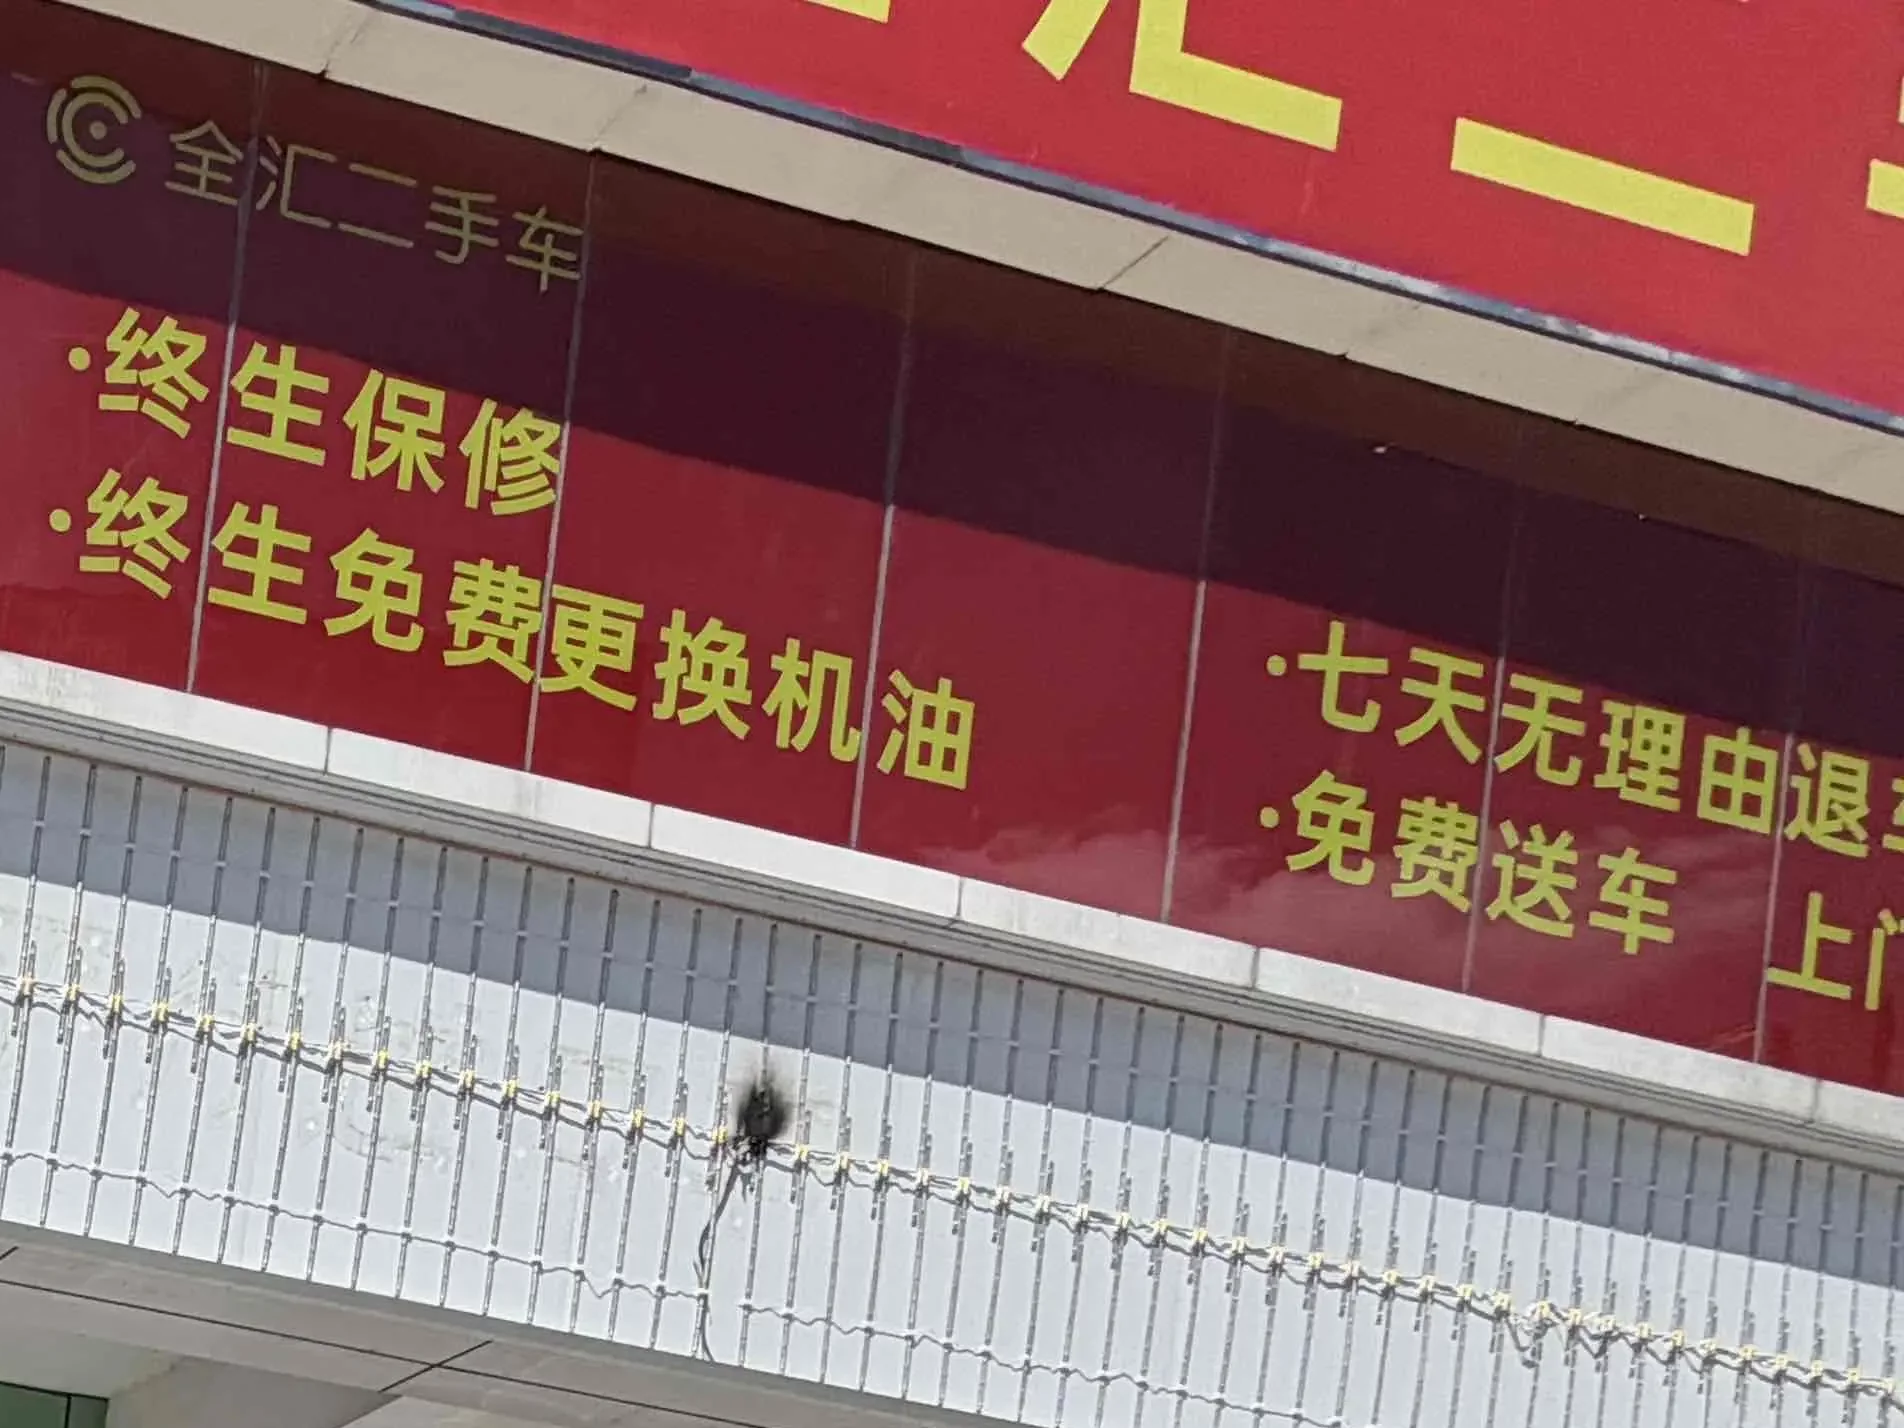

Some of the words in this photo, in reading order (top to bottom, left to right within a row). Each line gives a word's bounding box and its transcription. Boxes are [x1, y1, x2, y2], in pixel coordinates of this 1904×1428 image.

[164, 119, 584, 294] 全汇二手车
[99, 307, 562, 515] 终生保修
[80, 469, 975, 790] 终生免费更换机油
[1298, 621, 1904, 858] 七天无理由退
[1287, 770, 1677, 955] 免费送车
